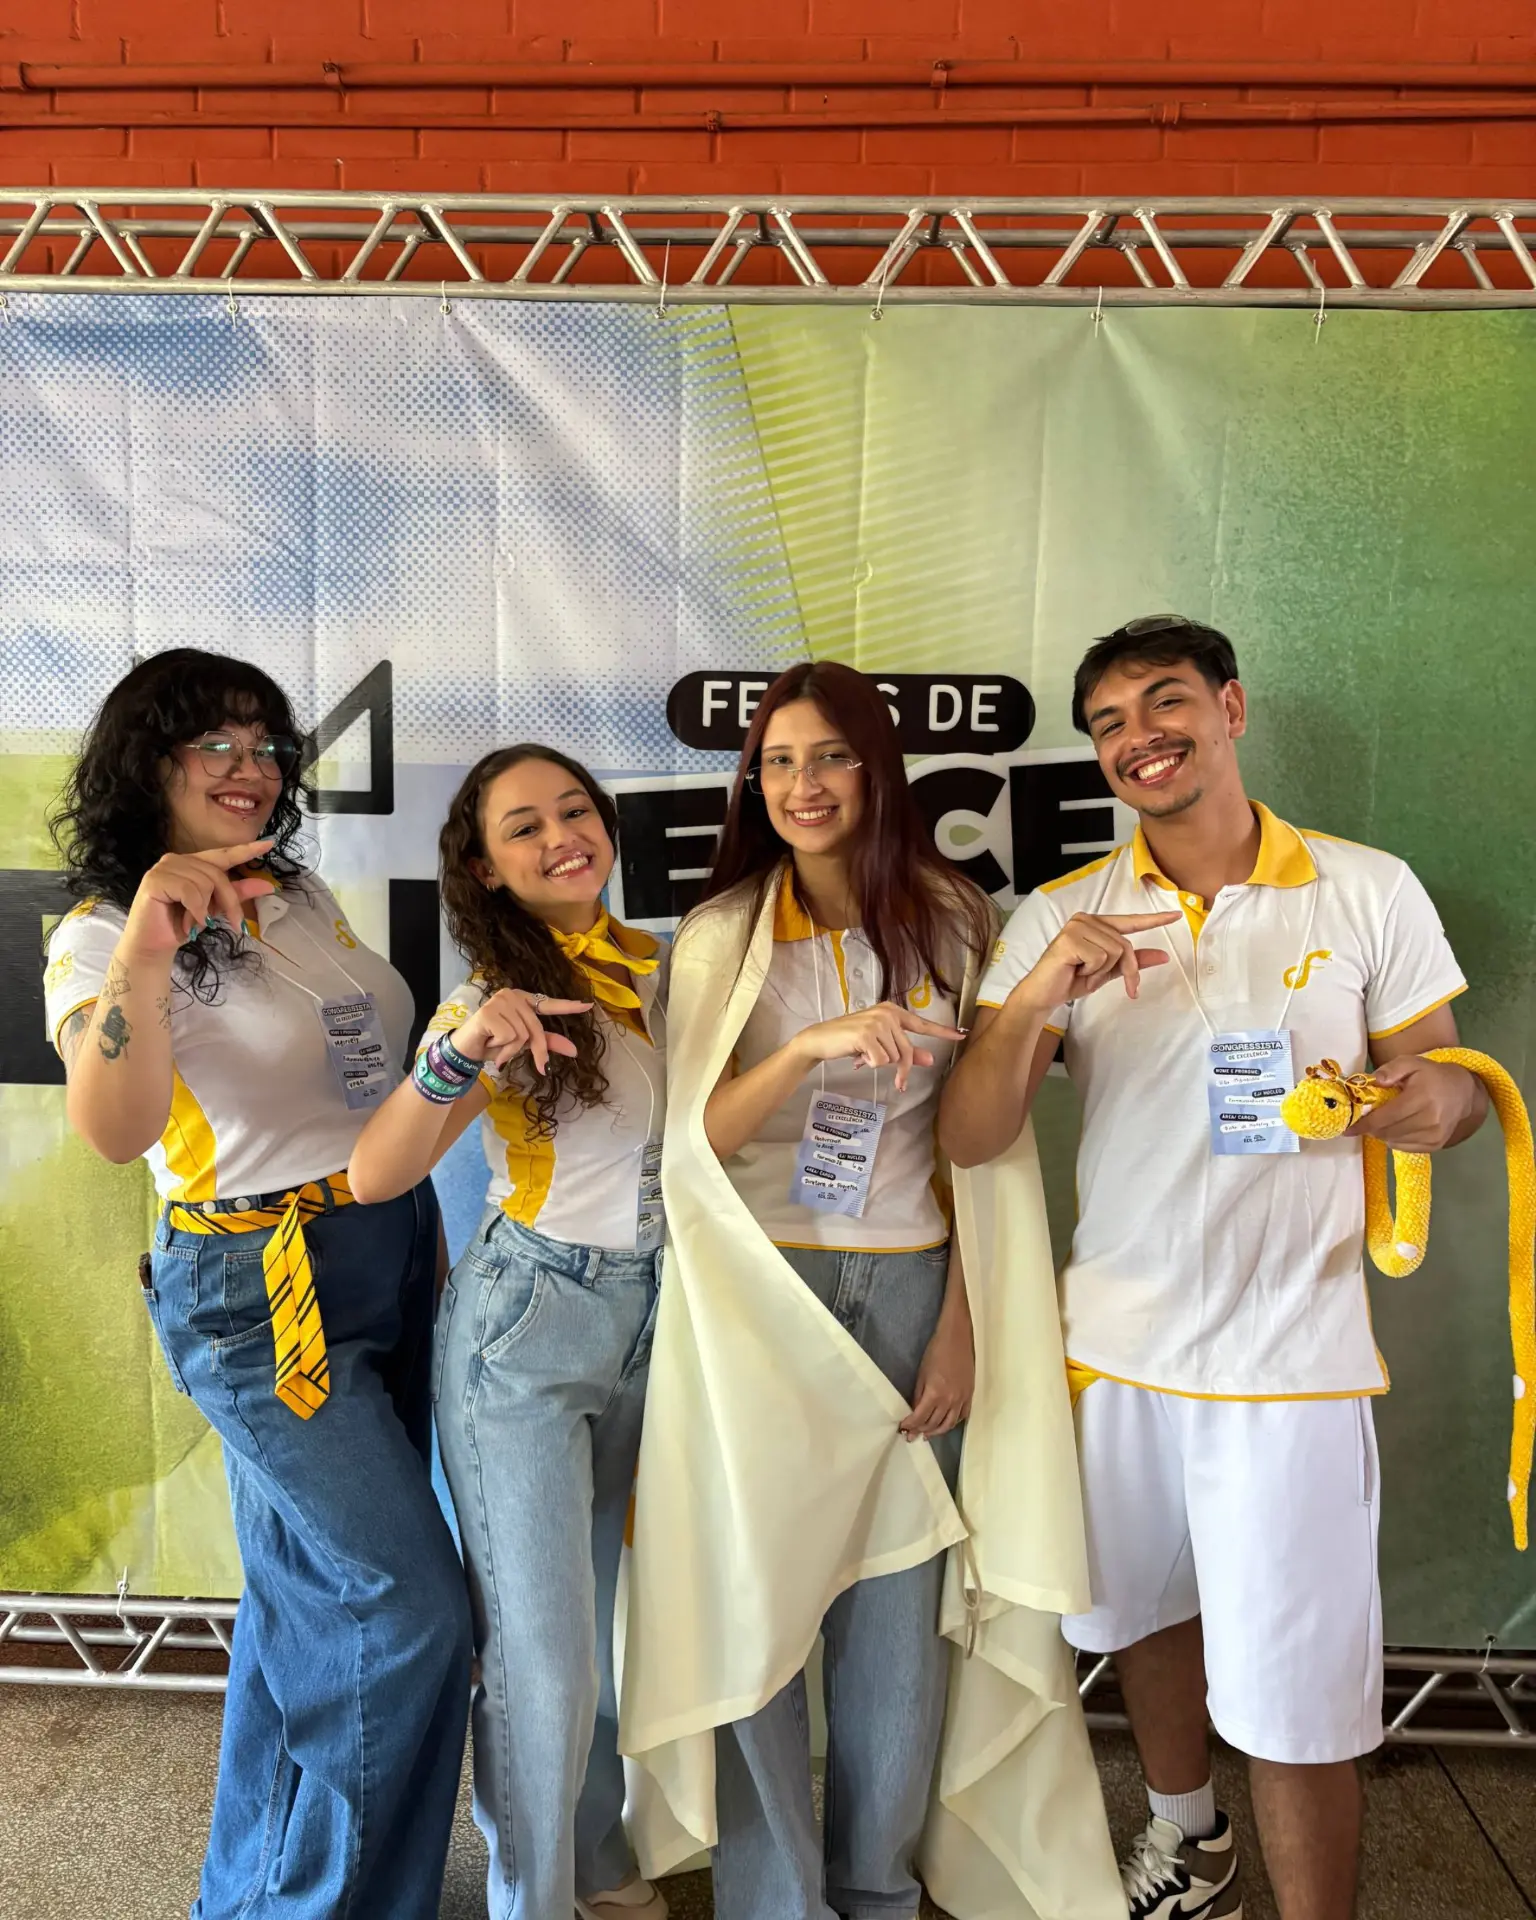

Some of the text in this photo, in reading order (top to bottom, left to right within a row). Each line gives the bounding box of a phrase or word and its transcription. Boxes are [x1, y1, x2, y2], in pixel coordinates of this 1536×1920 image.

[928, 684, 1003, 732] DE
[1211, 1041, 1283, 1053] CONGRESSISTA
[1237, 1051, 1269, 1060] EXCELÊNCIA
[817, 1101, 877, 1121] CONGRESSISTA
[835, 1114, 863, 1123] EXCELÊNCIA
